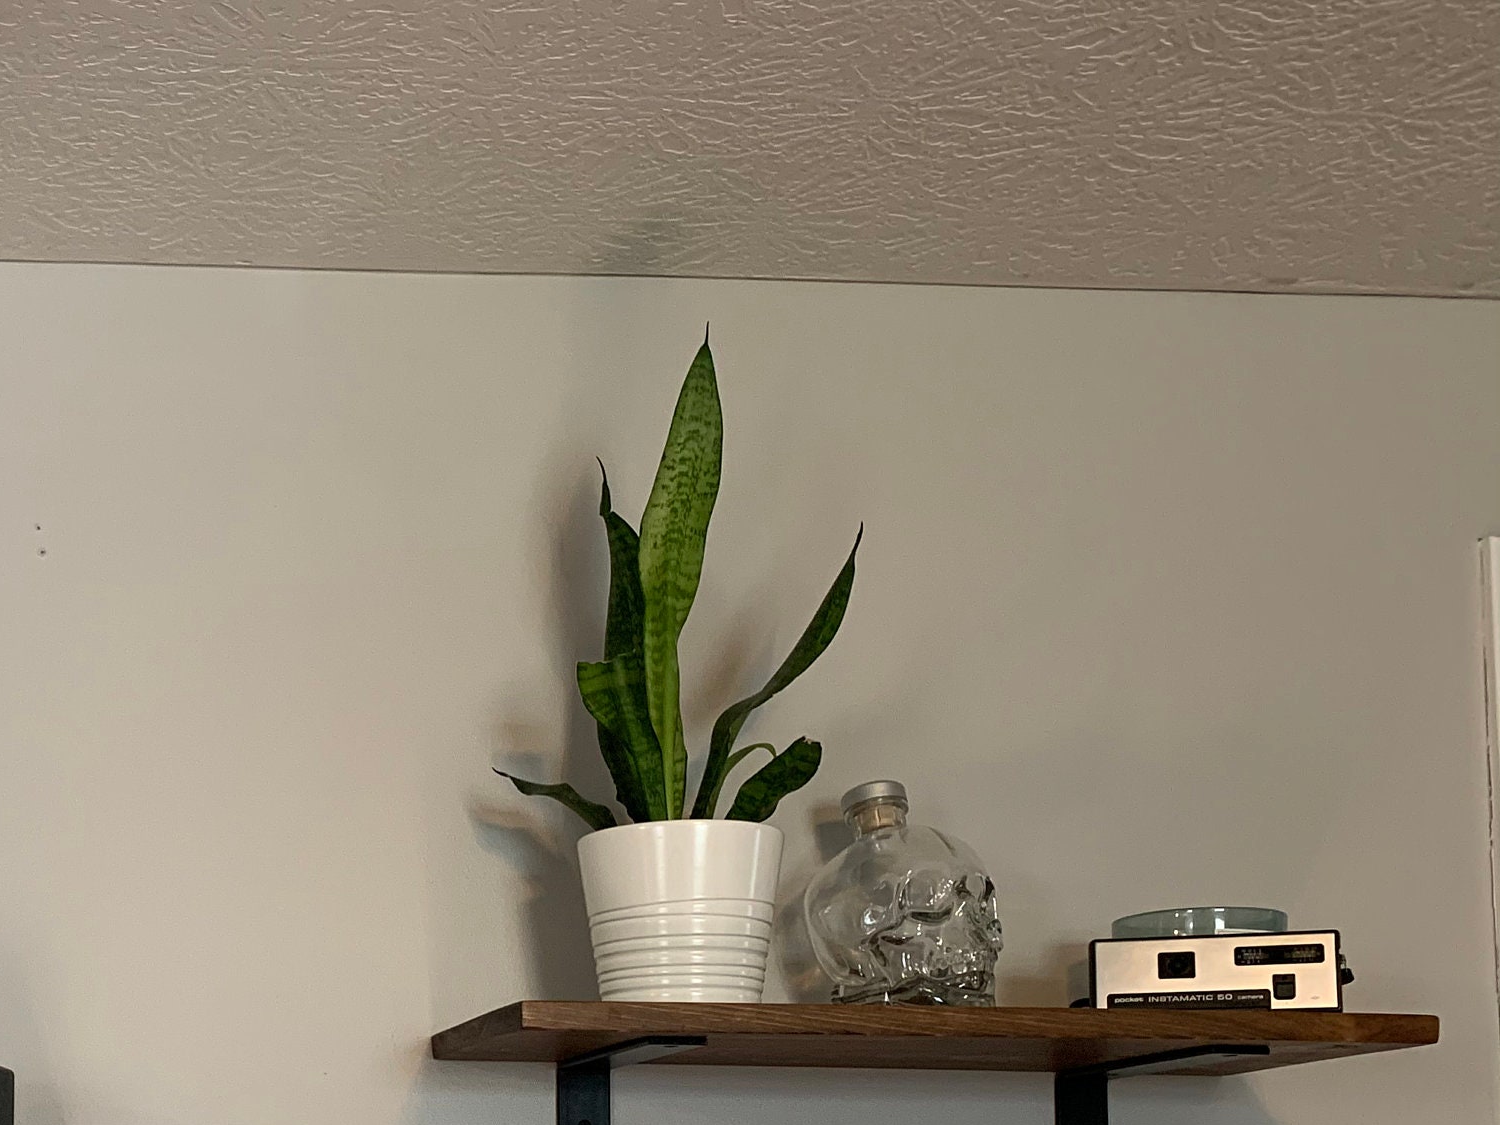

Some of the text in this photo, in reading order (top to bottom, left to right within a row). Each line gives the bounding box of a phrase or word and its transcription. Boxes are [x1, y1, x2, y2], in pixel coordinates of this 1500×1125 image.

[1114, 996, 1144, 1004] pocket
[1148, 994, 1214, 1003] INSTAMATIC
[1217, 993, 1233, 1001] 50
